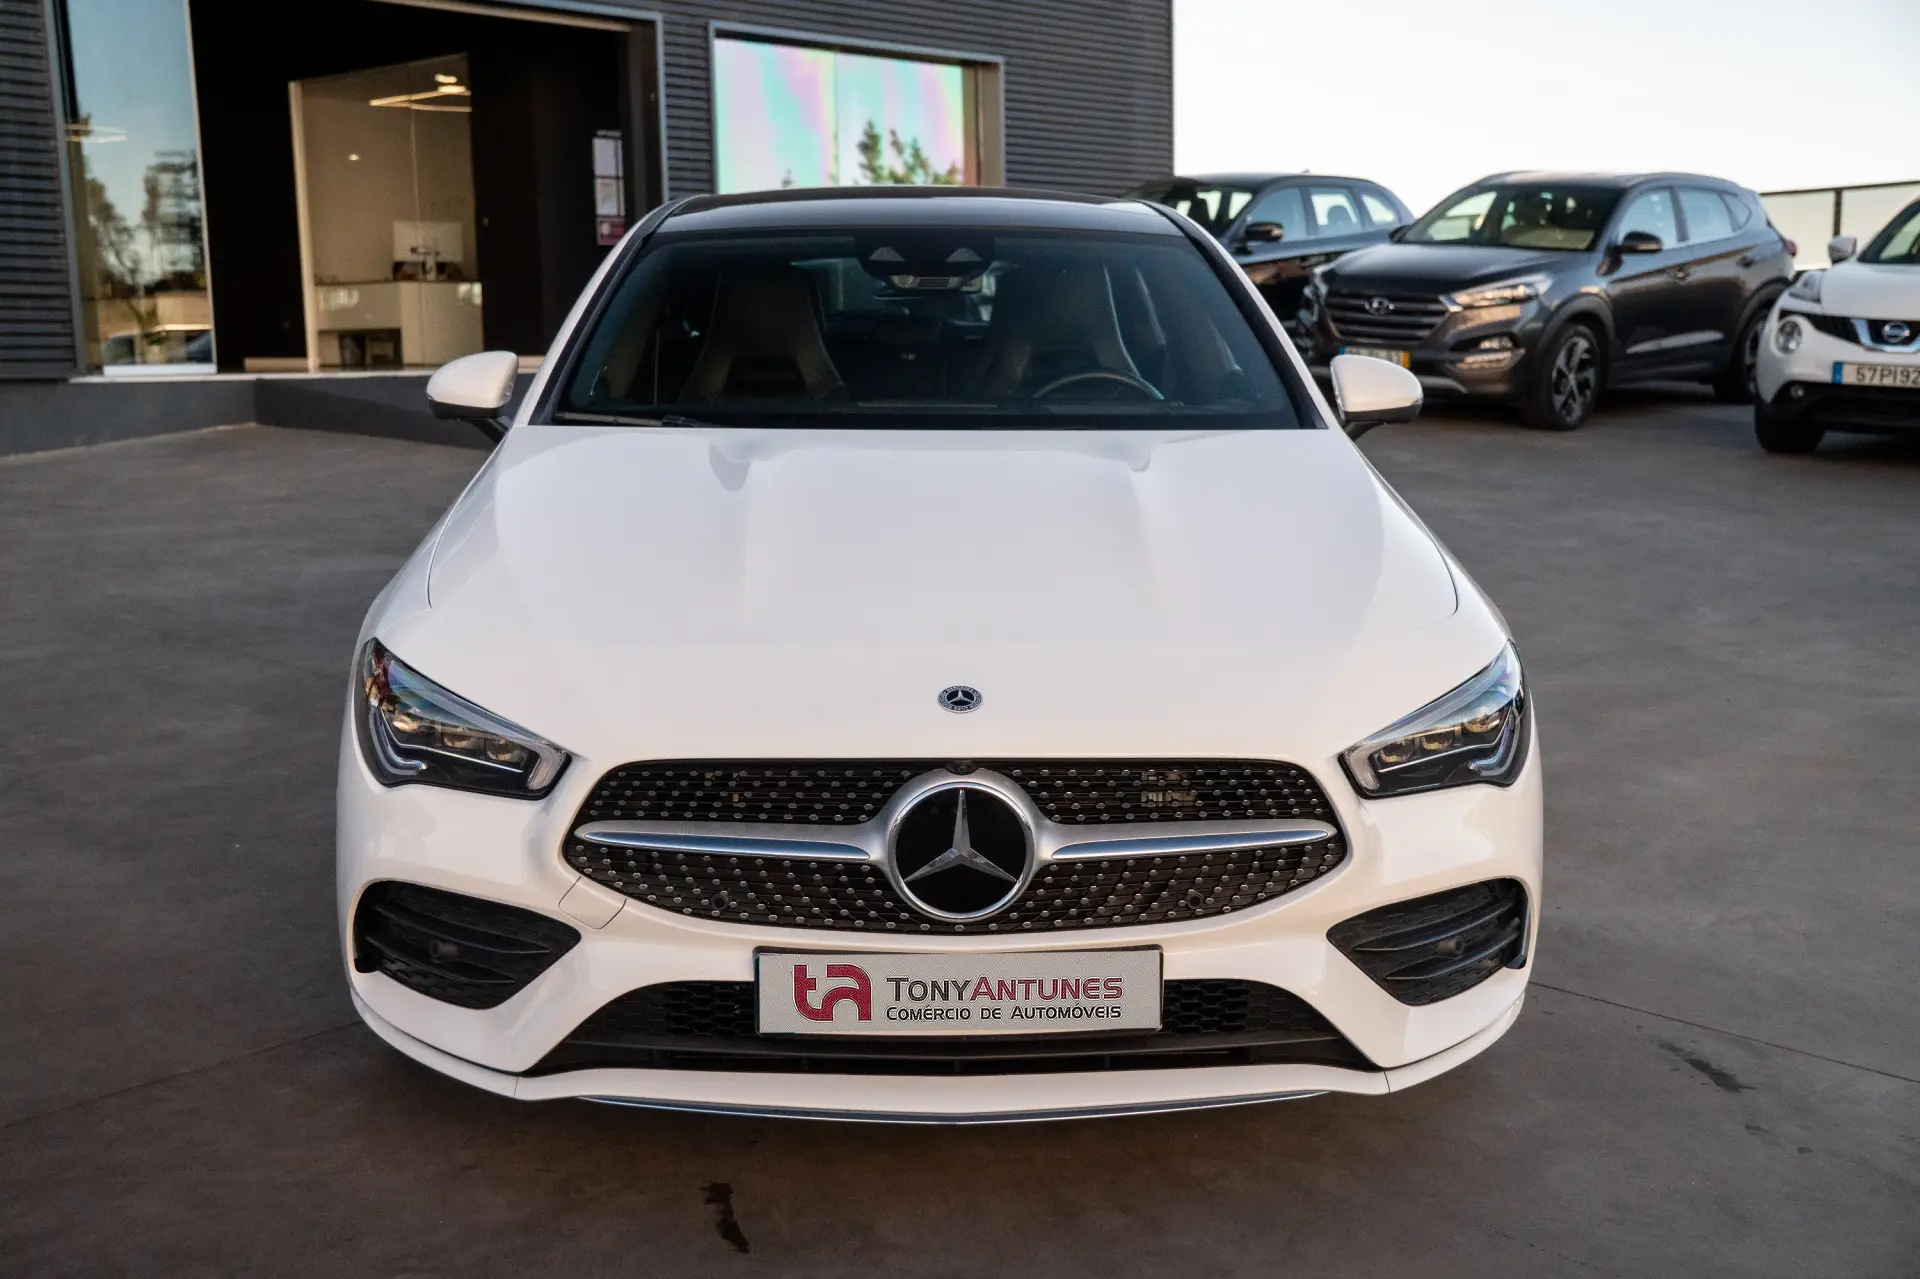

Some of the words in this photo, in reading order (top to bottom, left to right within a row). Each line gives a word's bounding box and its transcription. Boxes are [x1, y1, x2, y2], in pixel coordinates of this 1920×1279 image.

[886, 1004, 971, 1021] COMÉRCIO
[980, 1007, 1002, 1020] DE
[1010, 1002, 1122, 1020] AUTOMÓVEIS
